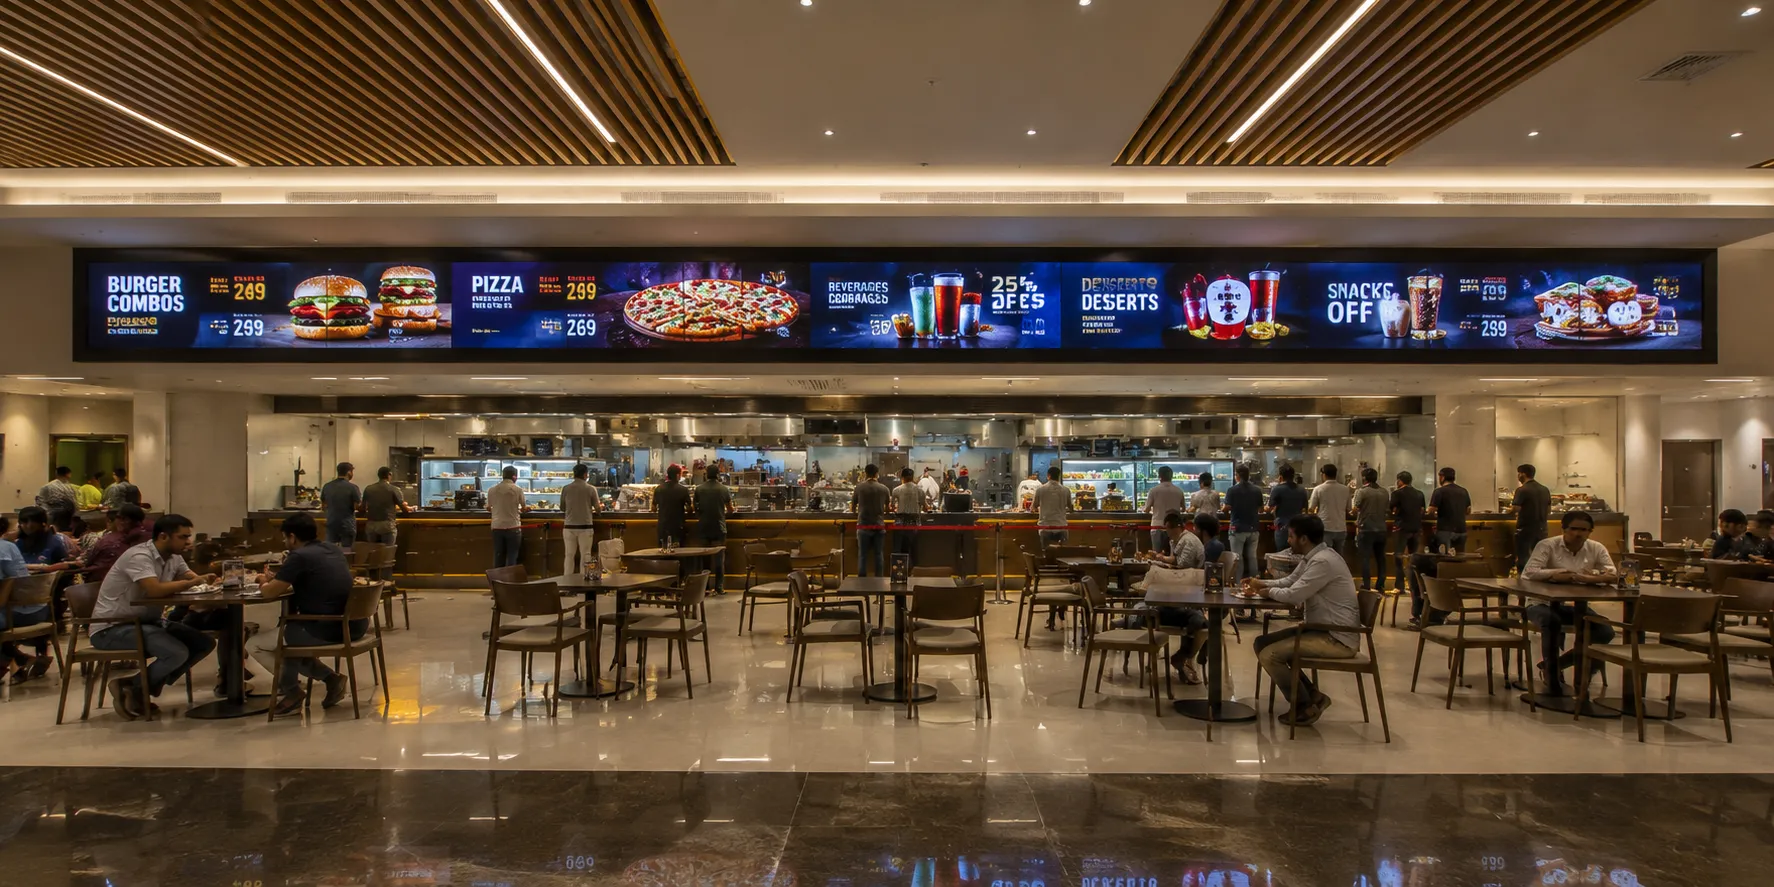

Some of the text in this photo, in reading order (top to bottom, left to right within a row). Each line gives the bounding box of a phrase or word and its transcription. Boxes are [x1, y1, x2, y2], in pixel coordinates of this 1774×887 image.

[107, 275, 182, 293] BURGER
[472, 275, 524, 293] PIZZA
[566, 282, 597, 301] 299
[107, 294, 185, 312] COMBOS
[1082, 293, 1159, 311] DESSERTS
[1327, 301, 1374, 324] OFF
[566, 318, 597, 337] 269
